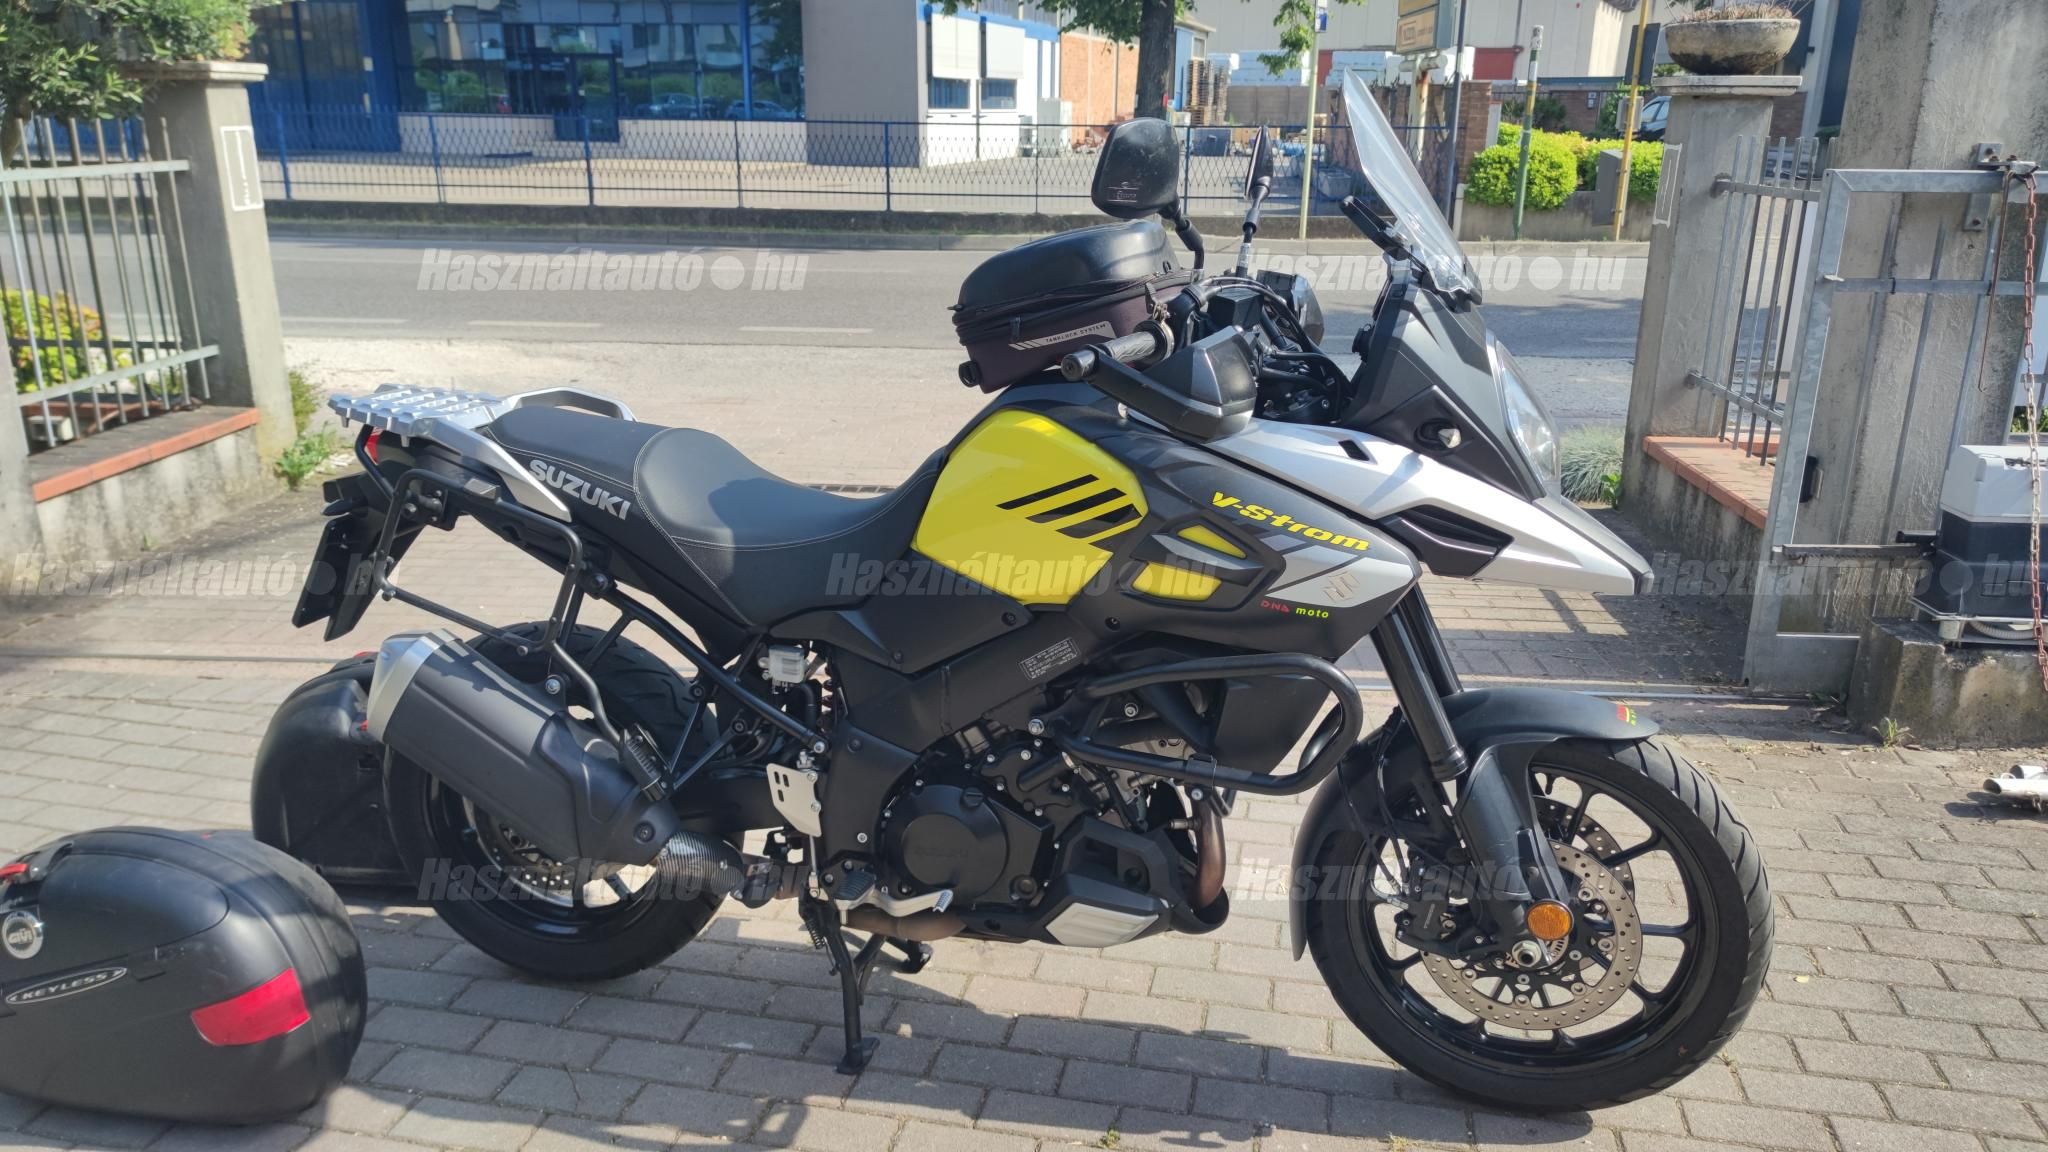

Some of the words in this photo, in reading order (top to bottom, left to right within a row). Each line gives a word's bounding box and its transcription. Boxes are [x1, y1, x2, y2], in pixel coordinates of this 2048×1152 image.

[1080, 323, 1106, 335] SYSTEM
[528, 459, 631, 521] SUZUKI
[1212, 491, 1370, 551] V-Strom
[1295, 607, 1329, 619] moto
[22, 972, 108, 1000] KEYLESS
